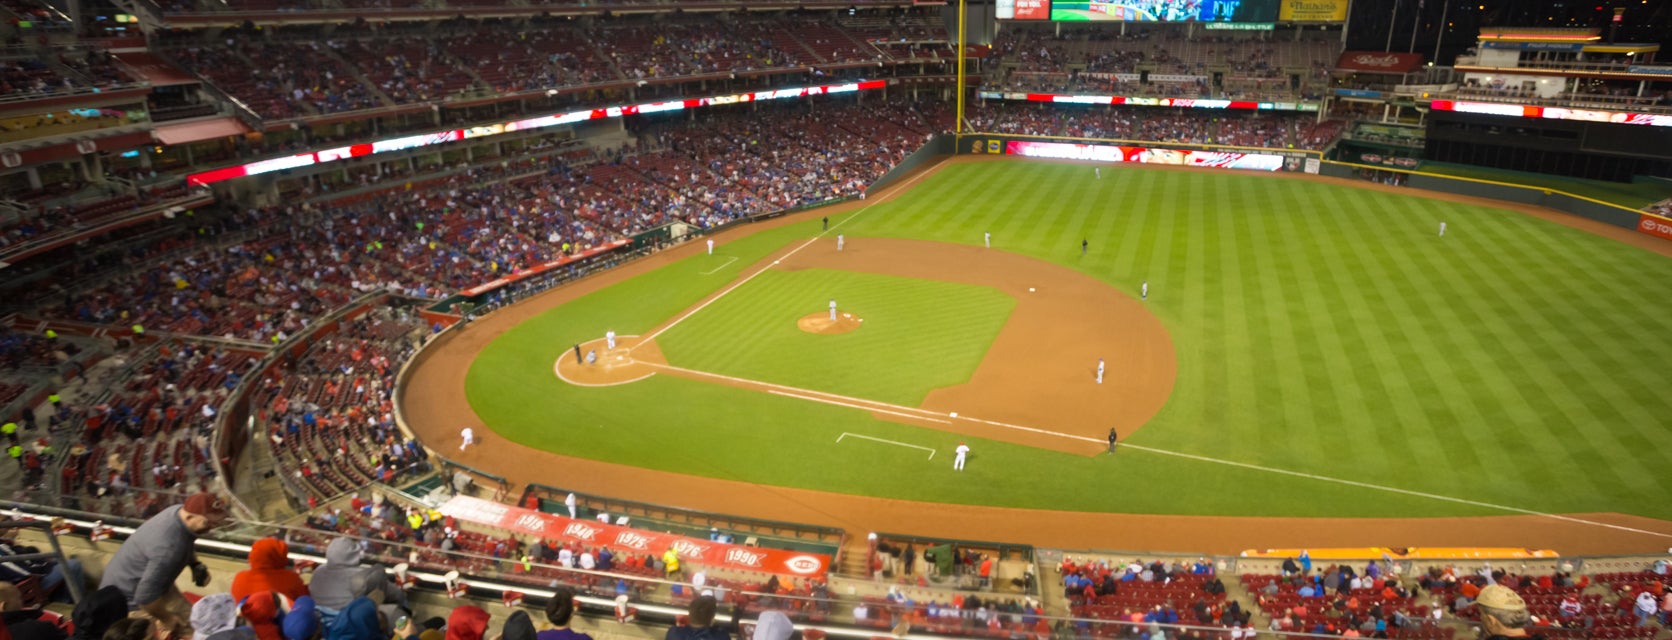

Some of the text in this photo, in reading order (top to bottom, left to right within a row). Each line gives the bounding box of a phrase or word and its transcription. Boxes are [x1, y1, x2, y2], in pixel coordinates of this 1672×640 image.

[566, 522, 595, 540] 1940
[618, 532, 647, 549] 1975
[672, 541, 701, 557] 1976
[728, 549, 758, 566] 1990
